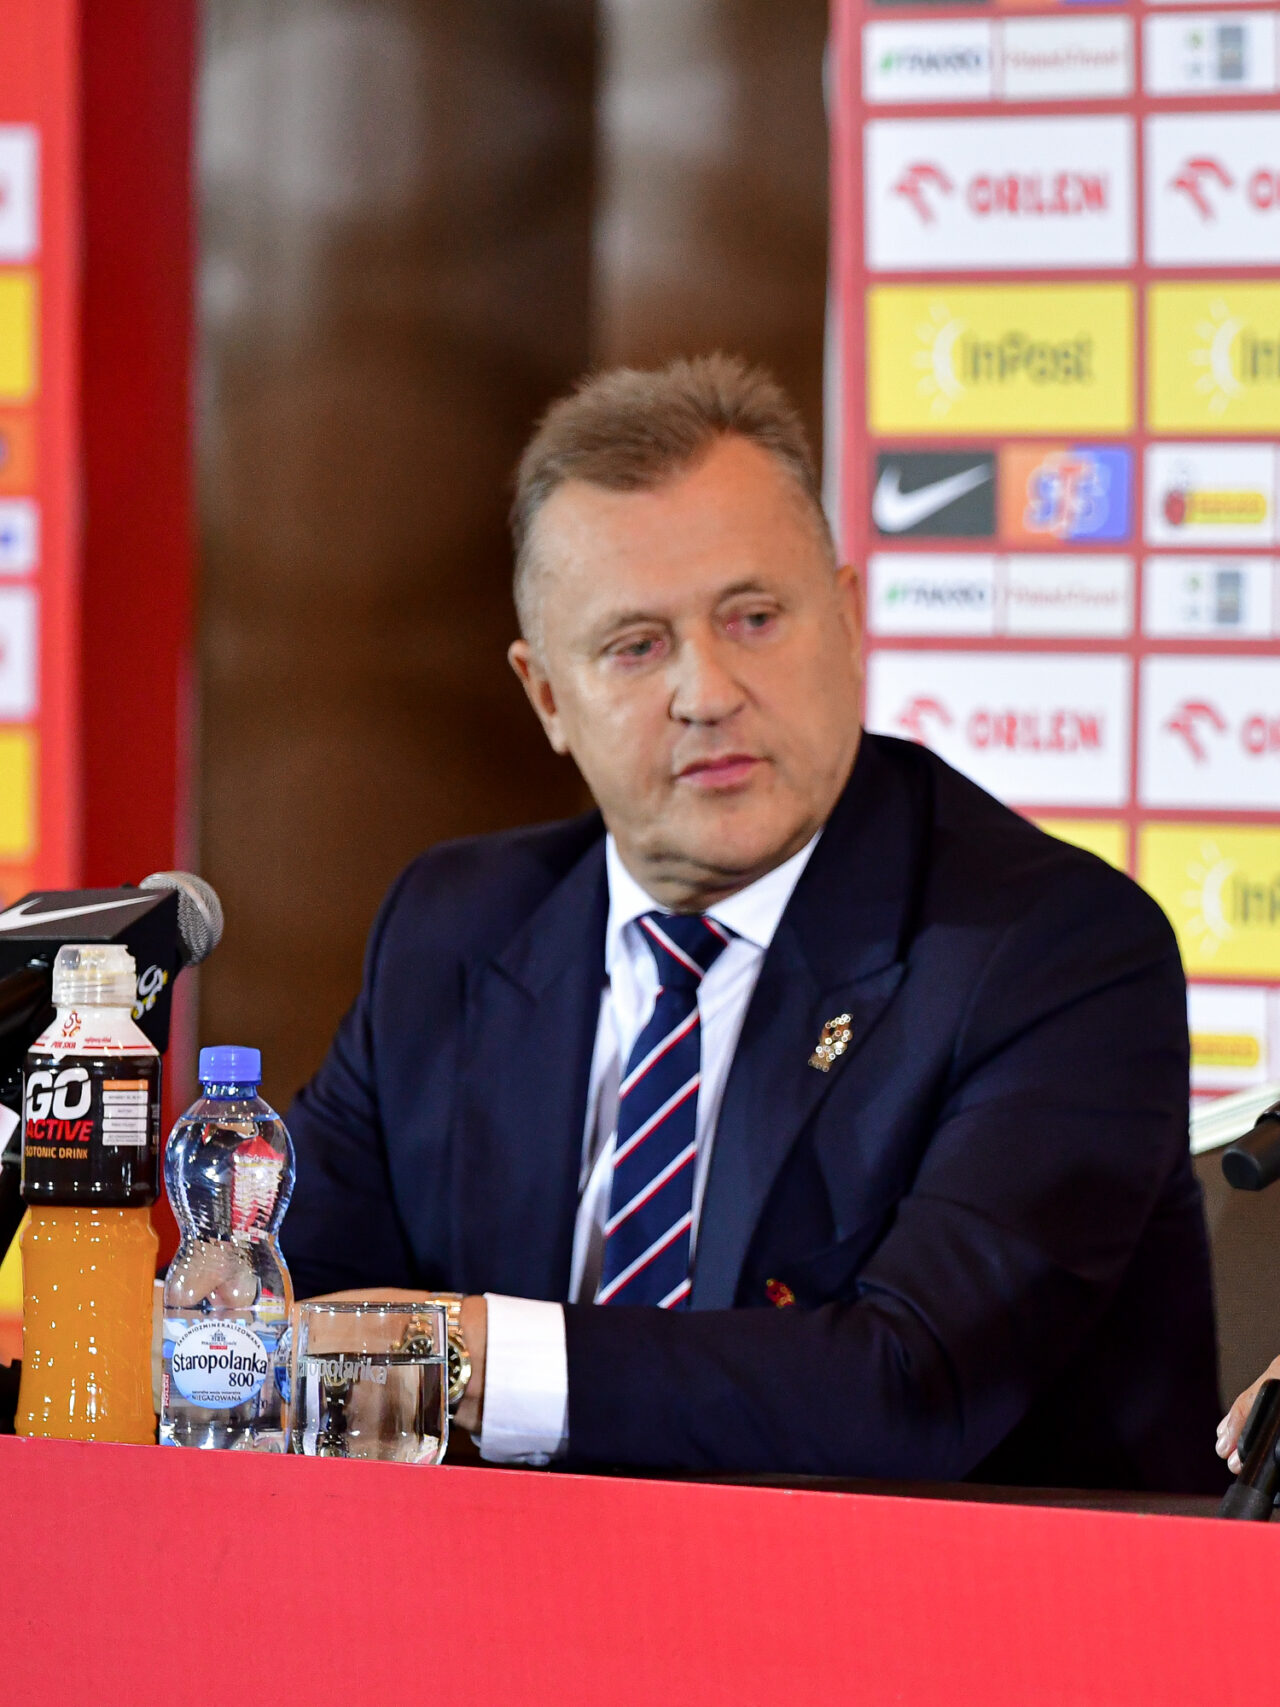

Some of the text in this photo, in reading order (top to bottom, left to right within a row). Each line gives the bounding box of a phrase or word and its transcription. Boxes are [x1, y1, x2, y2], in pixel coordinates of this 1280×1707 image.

[968, 173, 1108, 215] ORLEN
[966, 331, 1094, 382] InPost
[970, 709, 1106, 753] ORLEN
[26, 1067, 92, 1121] GO
[26, 1118, 94, 1142] ACTIVE
[25, 1145, 88, 1160] SOTONIC DRINK
[173, 1350, 267, 1375] Staropolanka
[228, 1372, 254, 1387] 800
